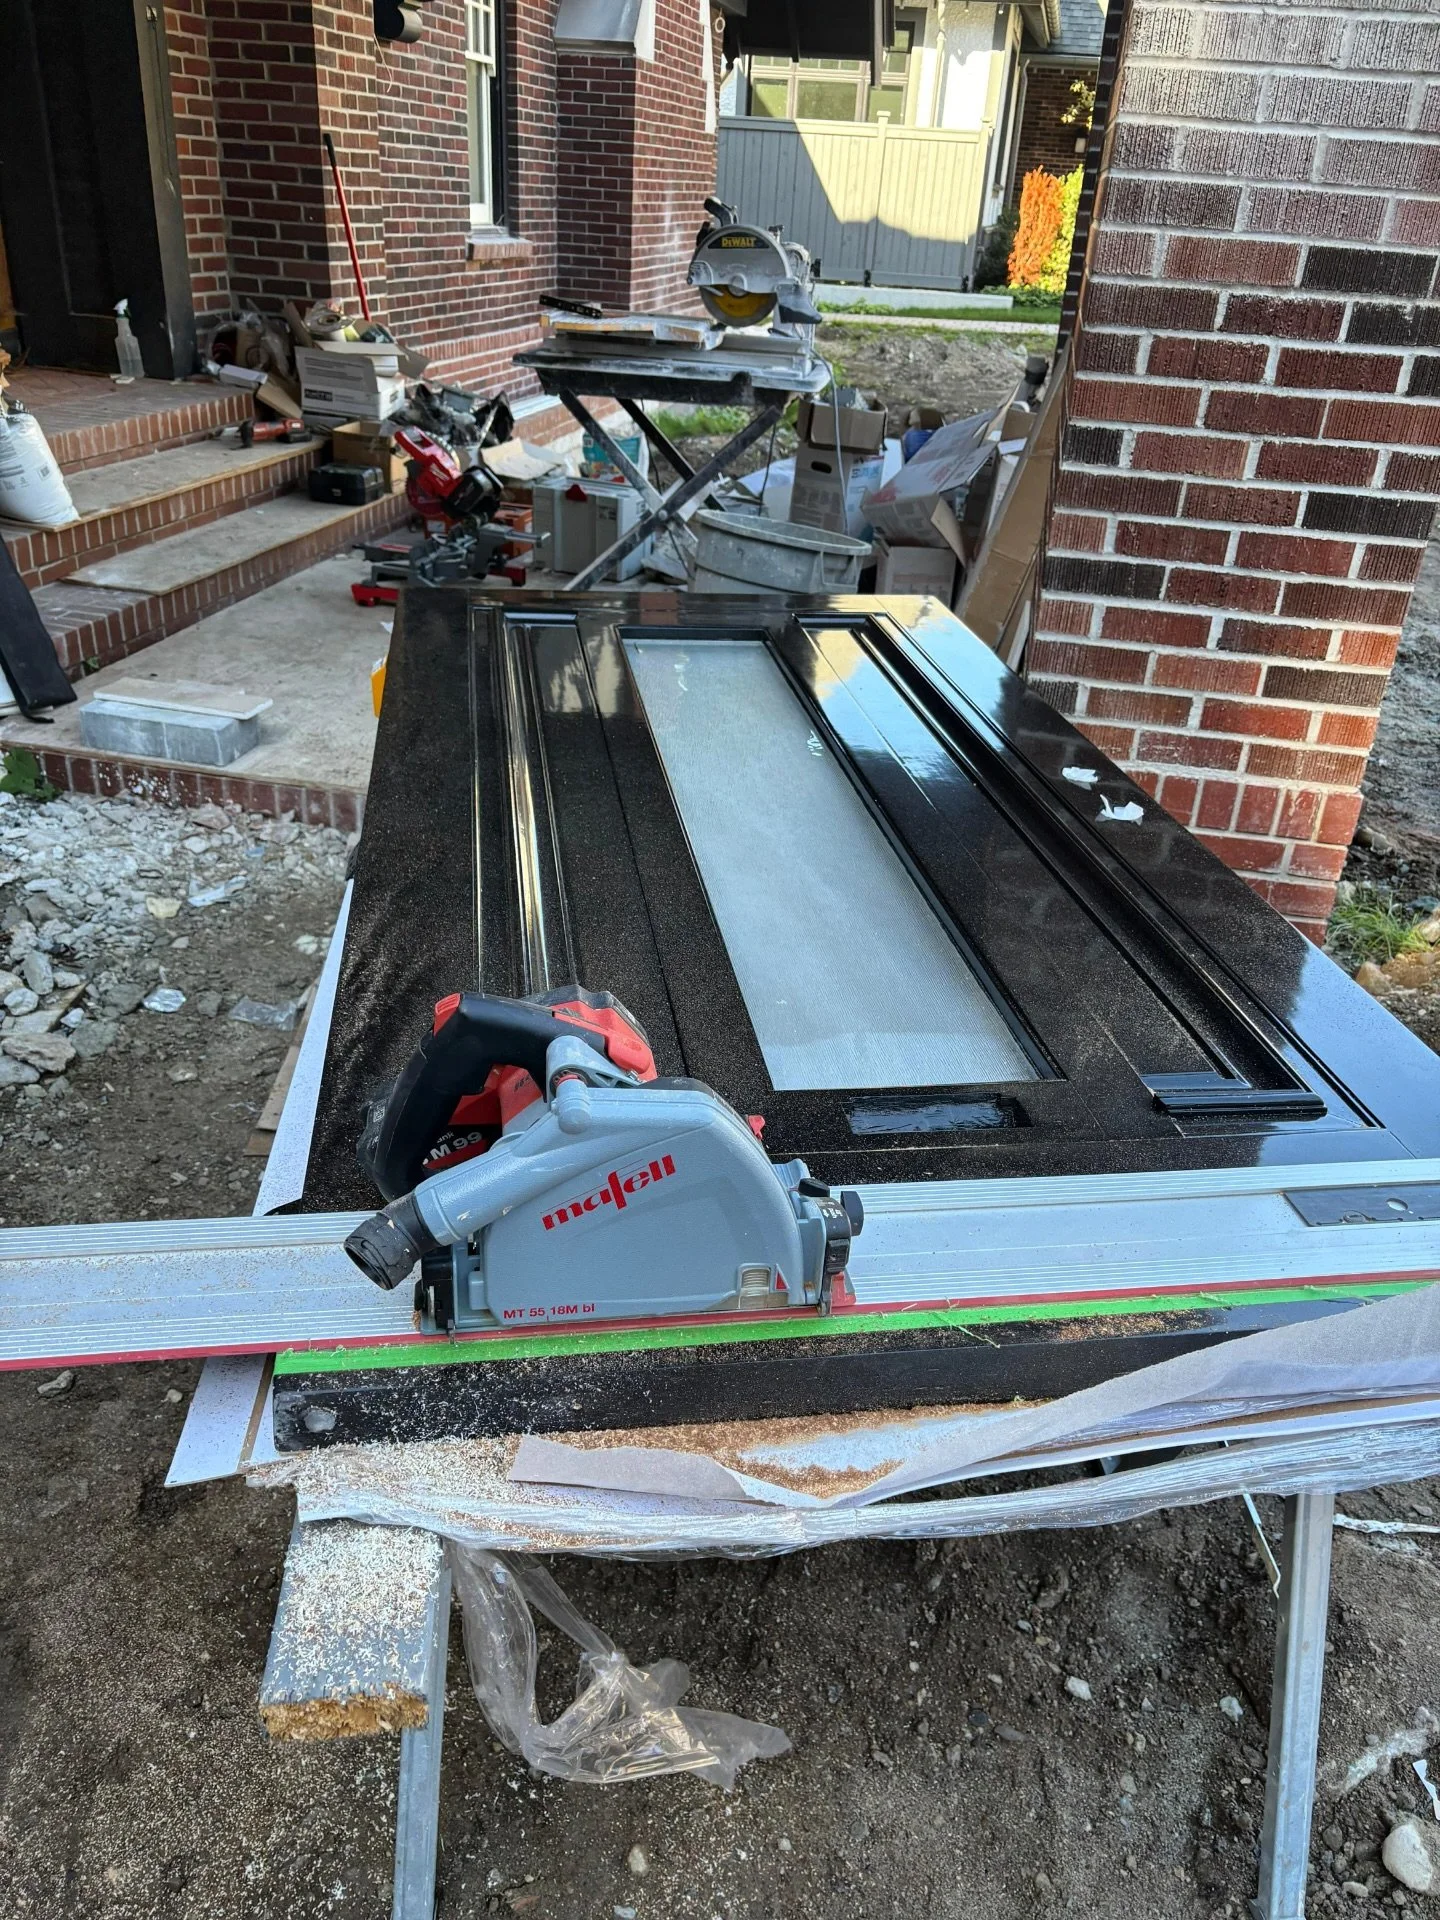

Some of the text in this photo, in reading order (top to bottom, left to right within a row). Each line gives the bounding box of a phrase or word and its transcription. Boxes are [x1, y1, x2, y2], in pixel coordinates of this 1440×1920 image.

[541, 1154, 676, 1231] mafell
[503, 1308, 525, 1319] MT
[529, 1307, 545, 1317] 55
[550, 1304, 578, 1315] 18M
